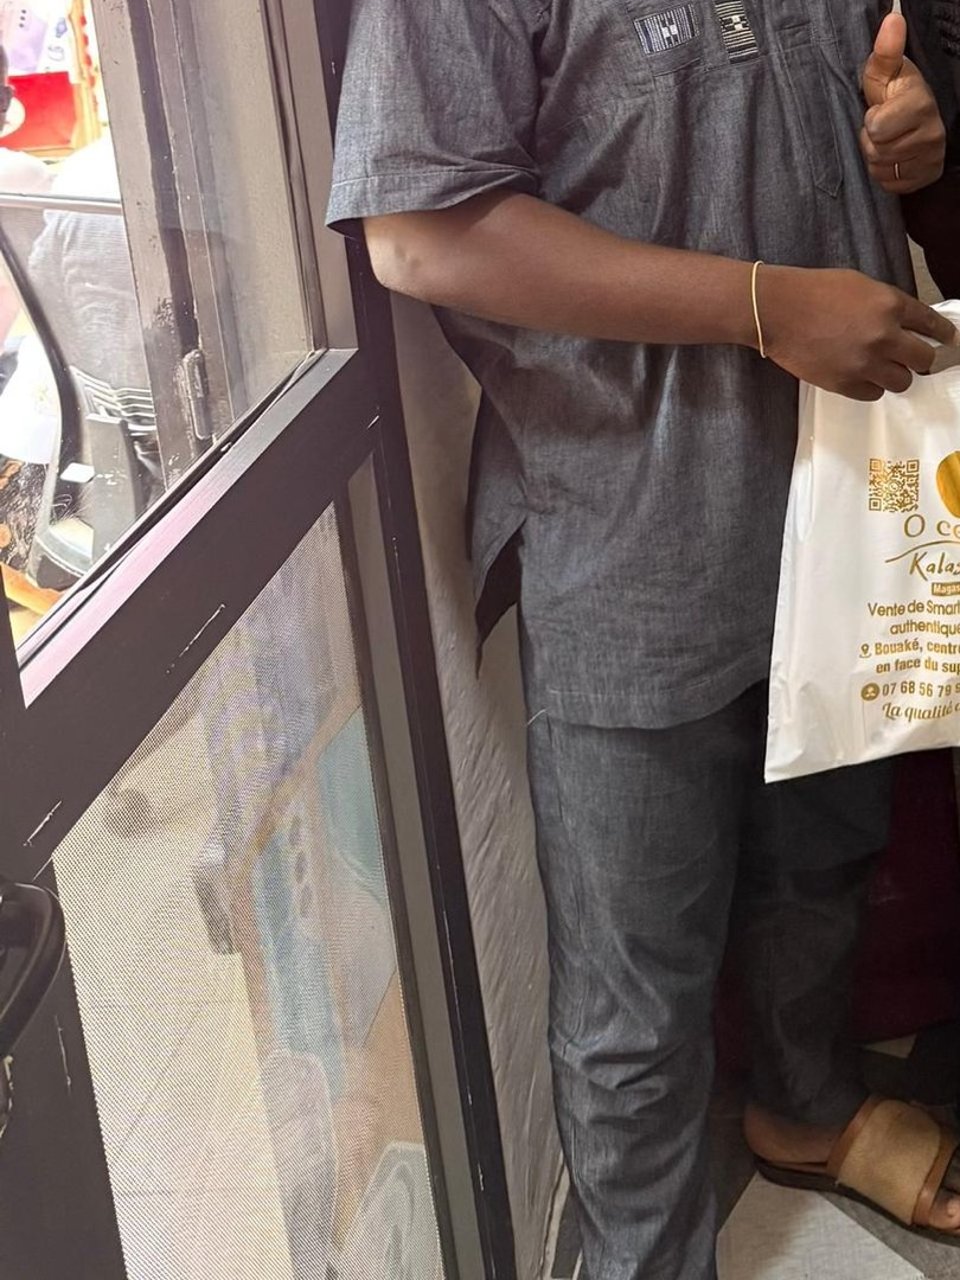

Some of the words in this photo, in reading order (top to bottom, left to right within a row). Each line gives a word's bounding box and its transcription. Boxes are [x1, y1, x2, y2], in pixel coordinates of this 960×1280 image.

[903, 513, 926, 538] O
[867, 601, 906, 618] Vente
[907, 600, 925, 614] de
[874, 637, 923, 656] Bouaké,
[876, 662, 891, 674] en
[894, 657, 921, 671] face
[924, 657, 939, 671] du
[882, 682, 896, 696] 07
[900, 680, 916, 694] 68
[919, 683, 933, 697] 56
[937, 683, 952, 698] 79
[882, 701, 901, 720] La
[904, 700, 953, 722] qualité
